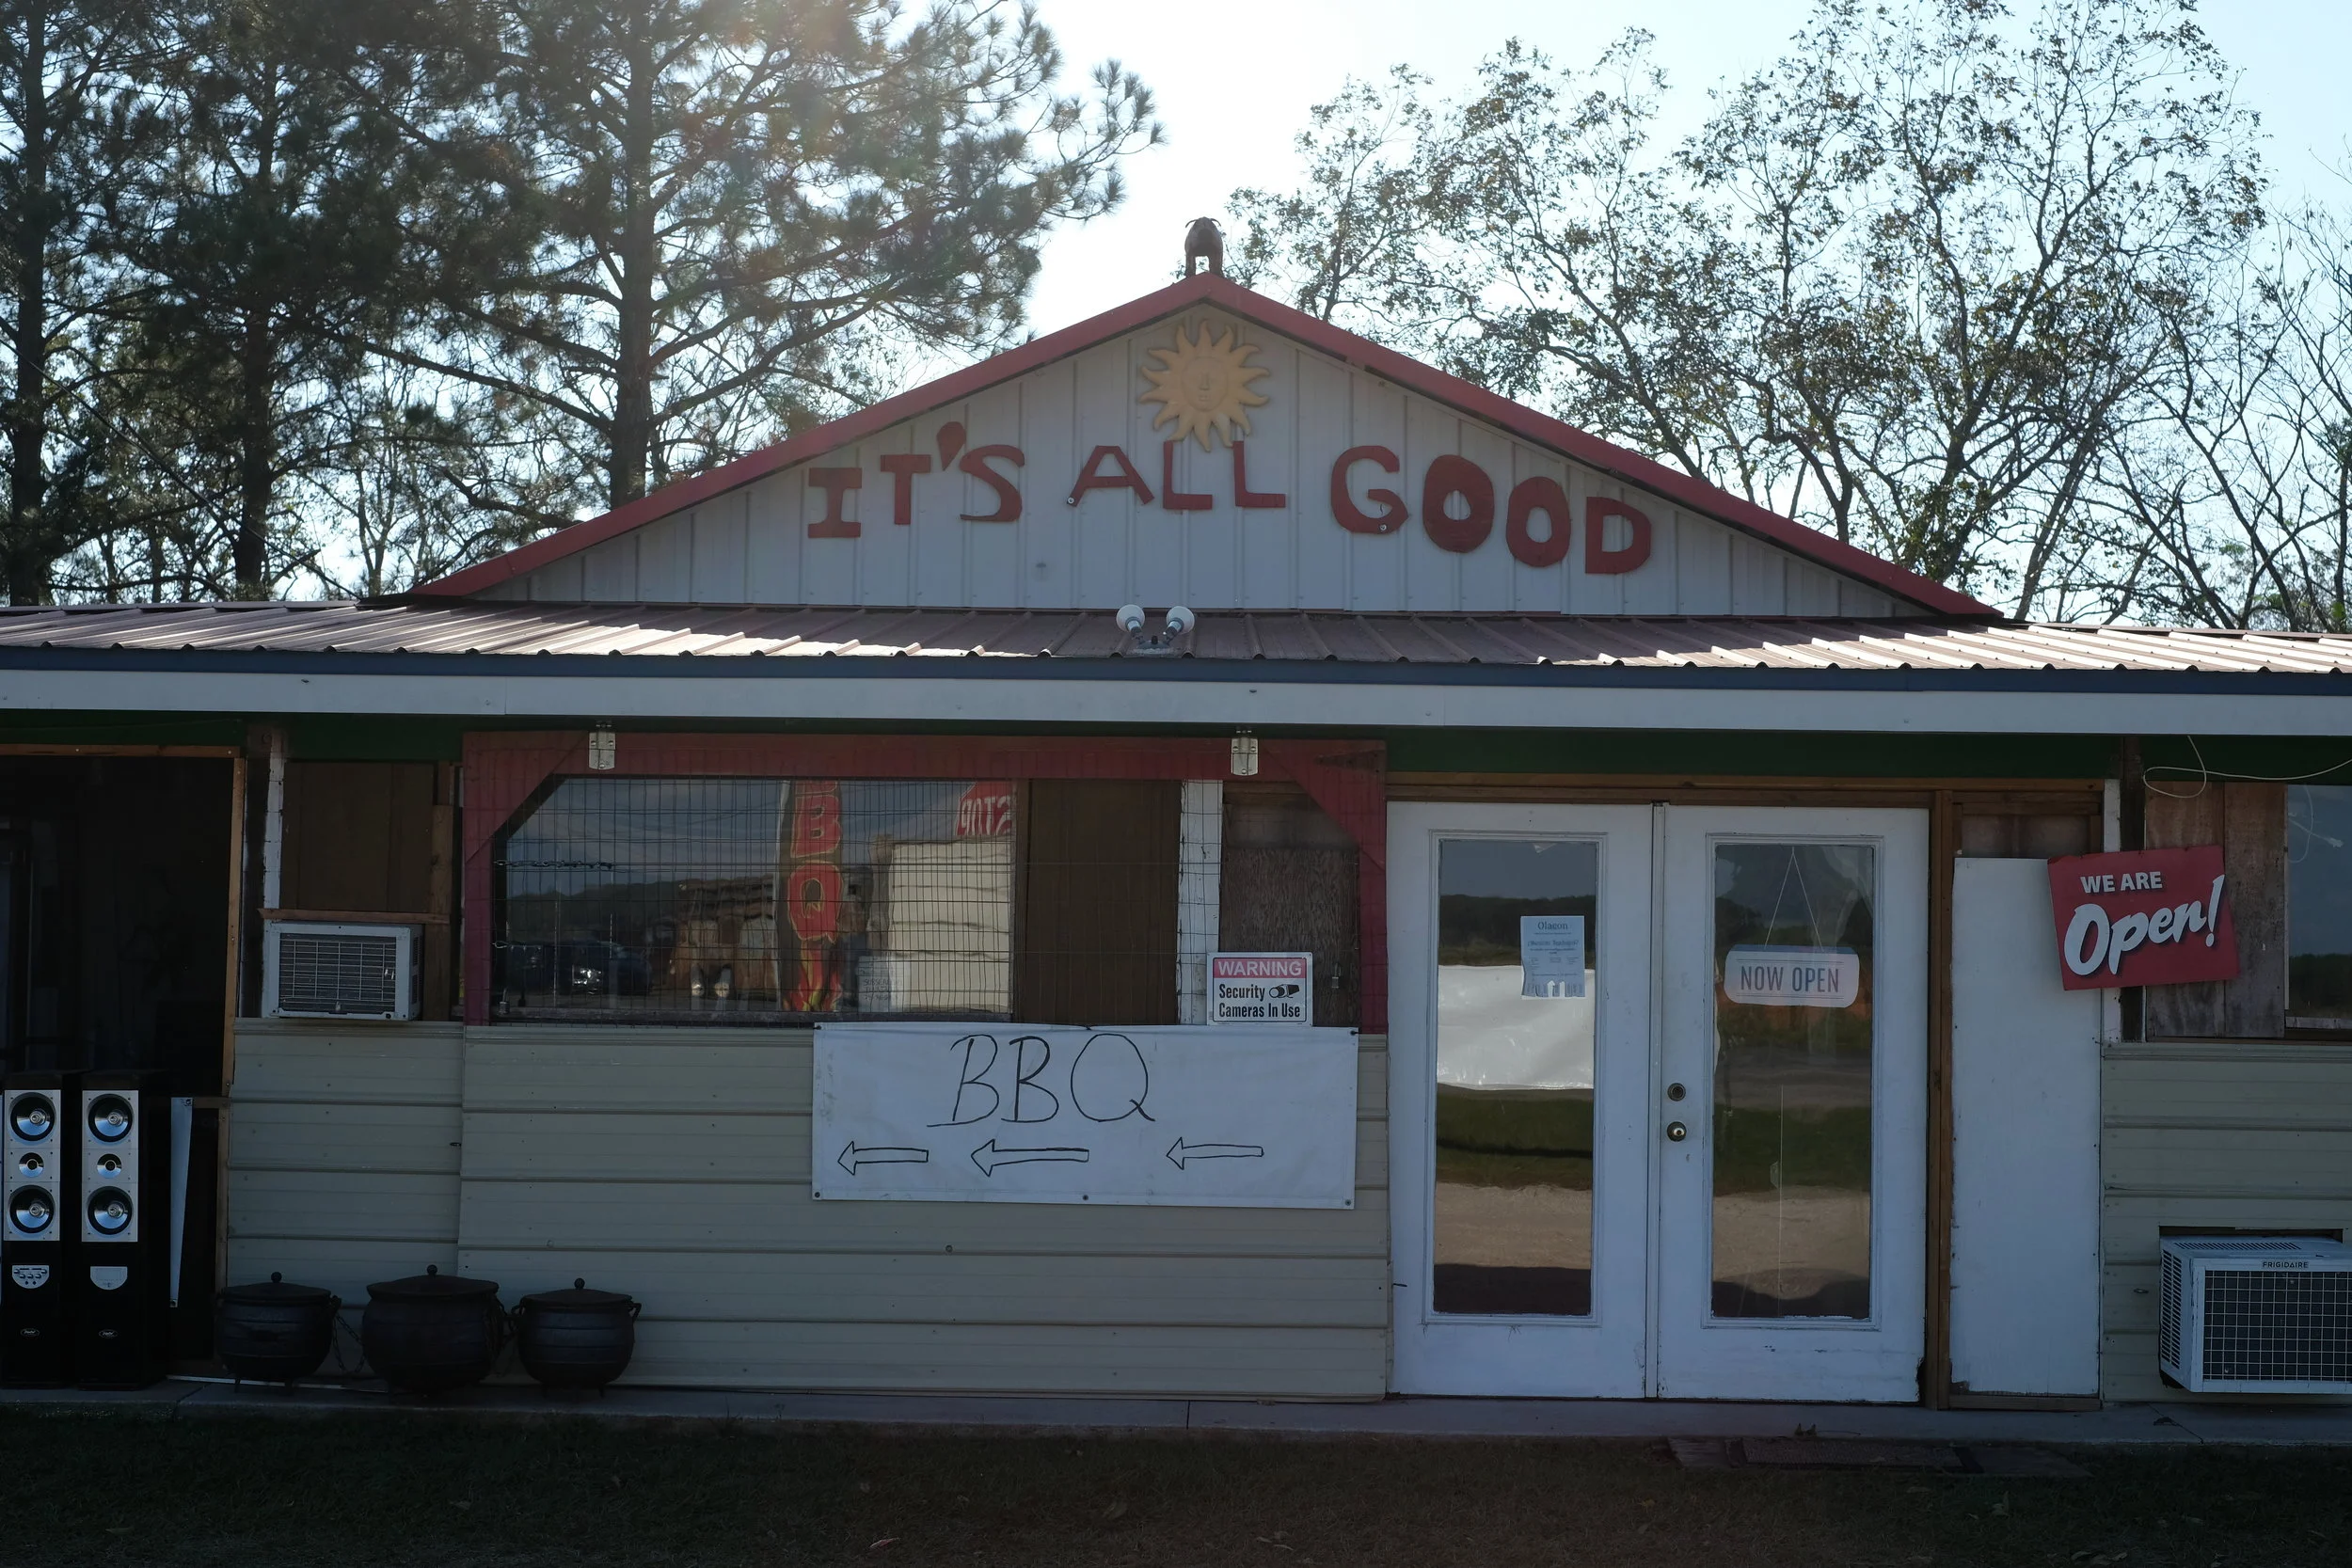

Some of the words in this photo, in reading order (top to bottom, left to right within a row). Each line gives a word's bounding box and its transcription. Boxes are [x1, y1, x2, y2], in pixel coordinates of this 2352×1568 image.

[806, 420, 1025, 539] IT'S
[1066, 439, 1287, 512] ALL
[1330, 444, 1653, 575] GOOD
[2080, 875, 2116, 894] WE
[2121, 871, 2163, 892] ARE
[2063, 874, 2226, 975] Open!
[1217, 960, 1302, 976] WARNING
[1740, 965, 1784, 991] NOW
[1791, 967, 1839, 993] OPEN
[1218, 983, 1265, 1002] Security
[1218, 1003, 1265, 1018] Cameras
[1268, 1003, 1279, 1018] In
[1281, 1003, 1300, 1018] Use
[927, 1033, 1155, 1127] BBQ
